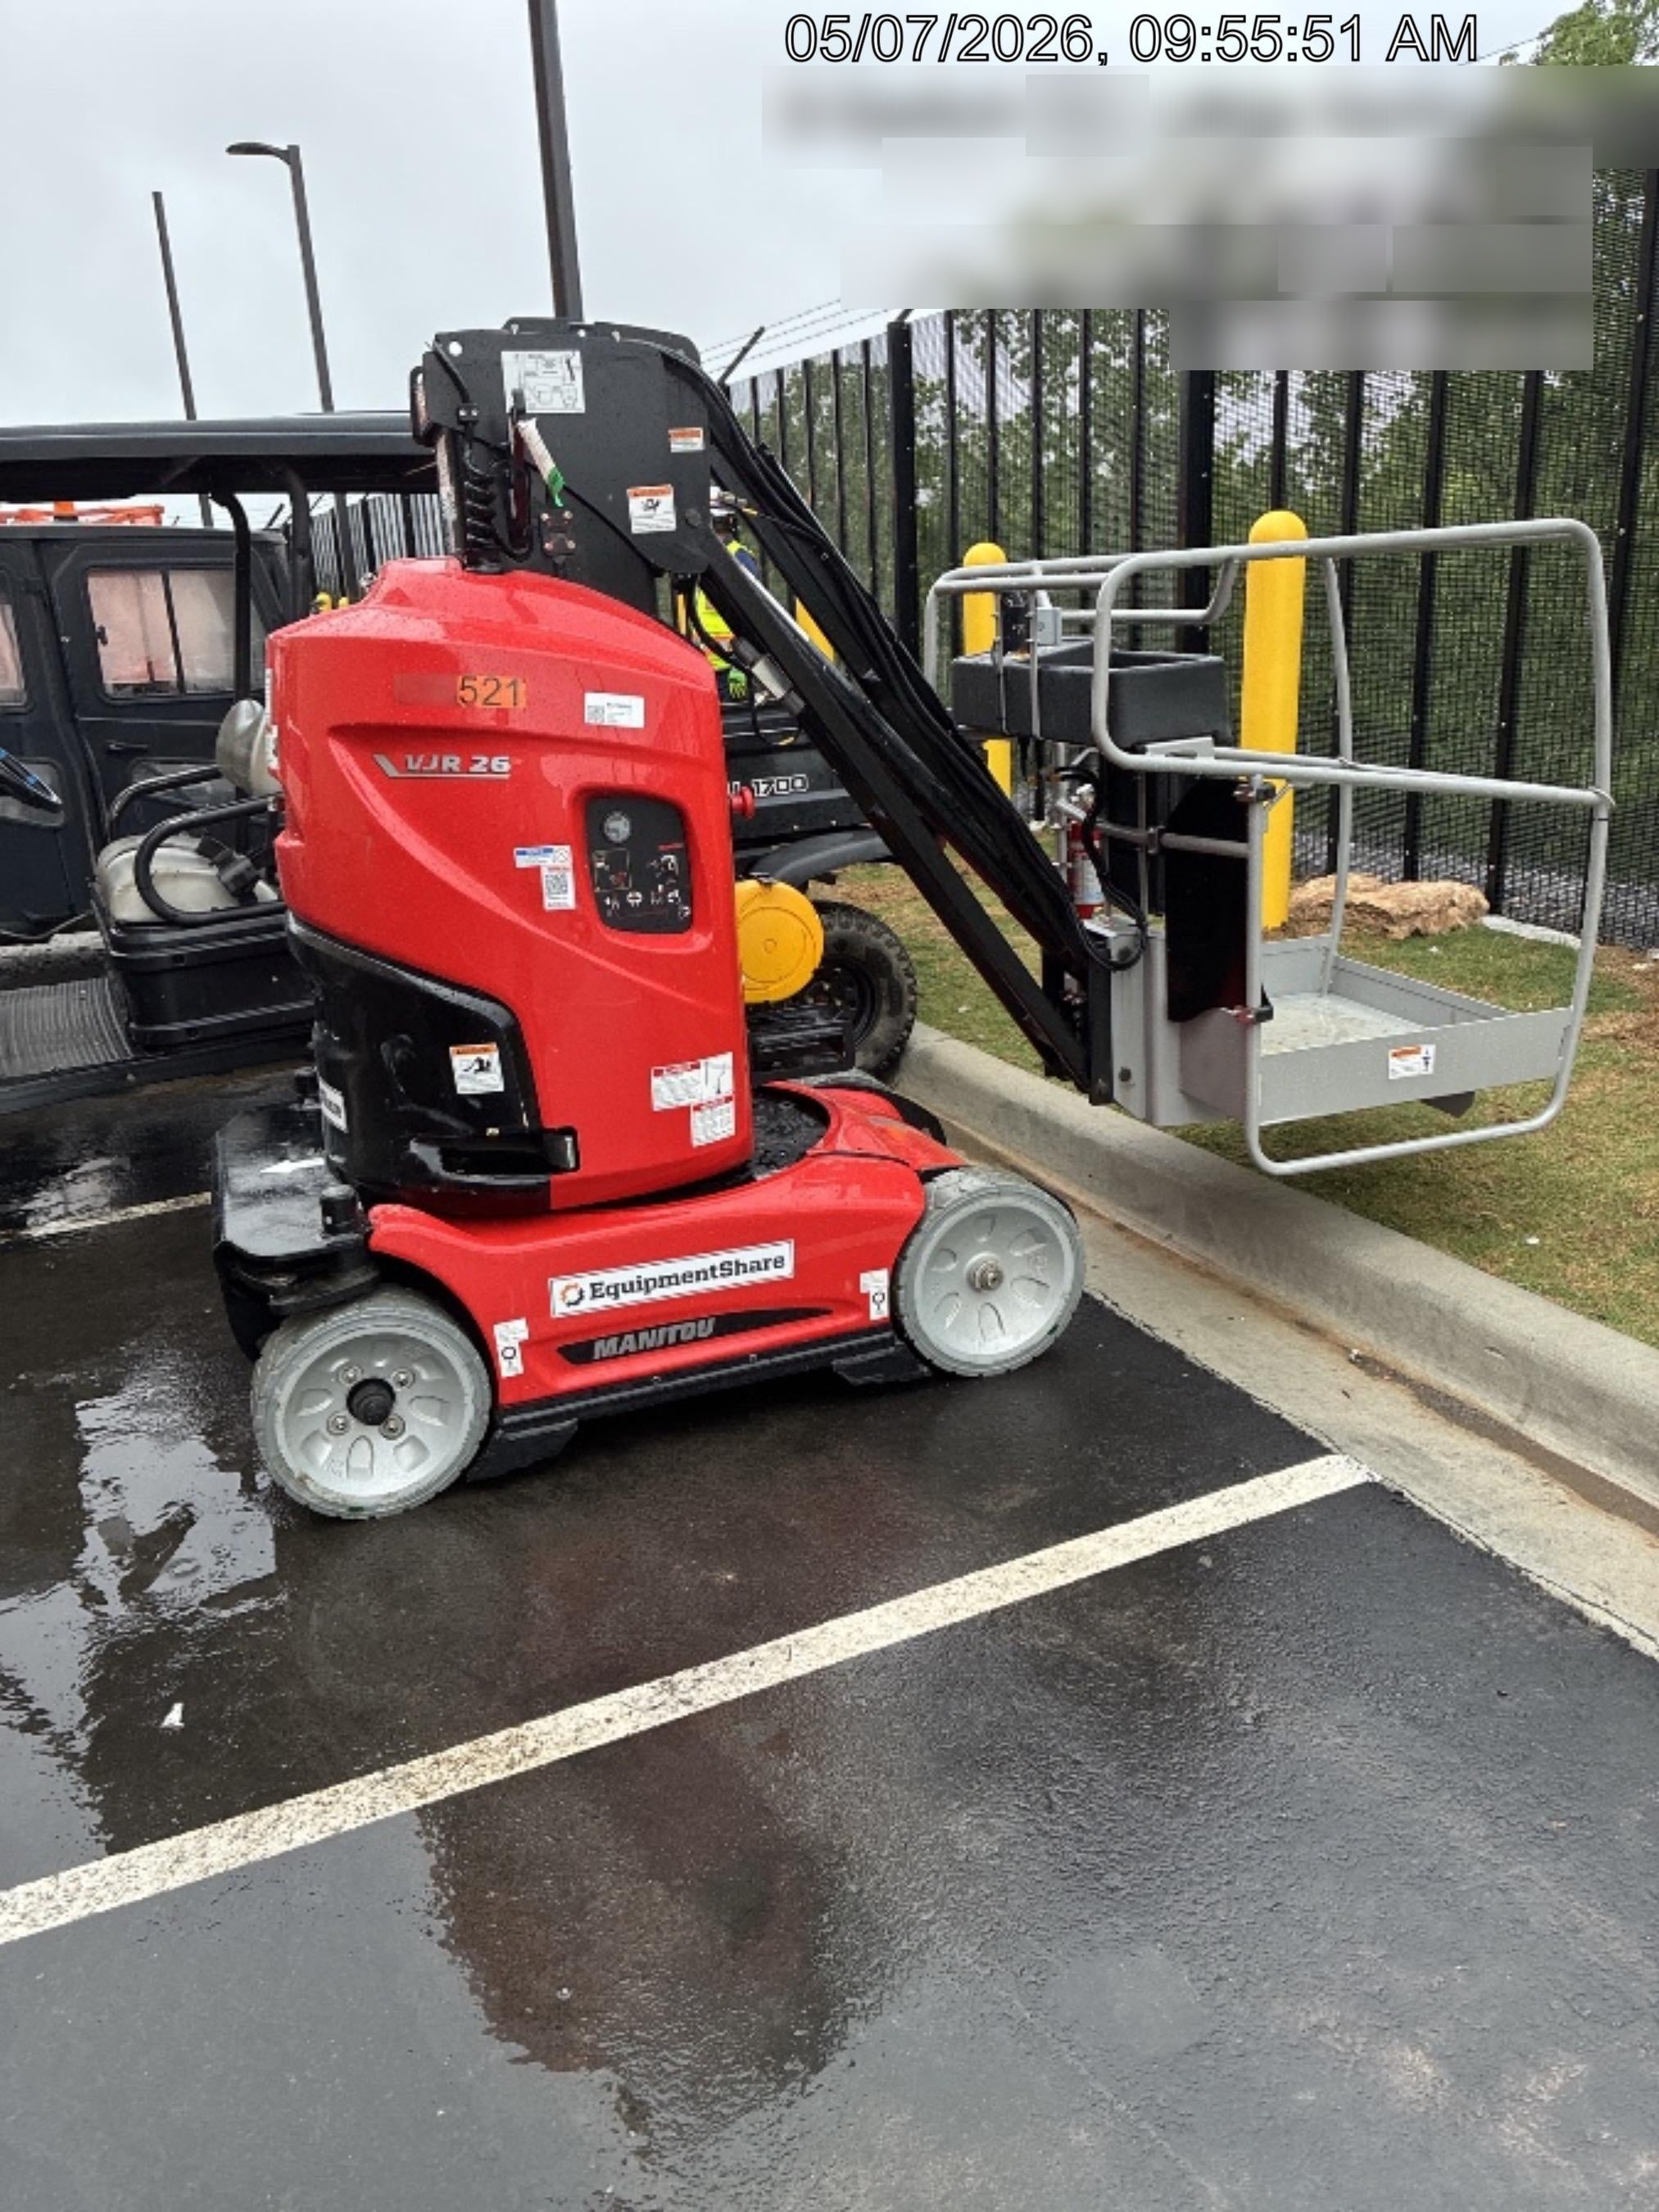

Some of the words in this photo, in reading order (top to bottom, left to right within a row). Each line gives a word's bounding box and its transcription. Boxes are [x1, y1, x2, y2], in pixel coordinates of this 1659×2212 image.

[459, 675, 519, 707] 521
[406, 754, 460, 773] VJR
[469, 755, 512, 773] 26
[751, 773, 809, 798] 1700
[589, 1253, 786, 1301] EquipmentShare
[592, 1317, 716, 1361] MANITOU
